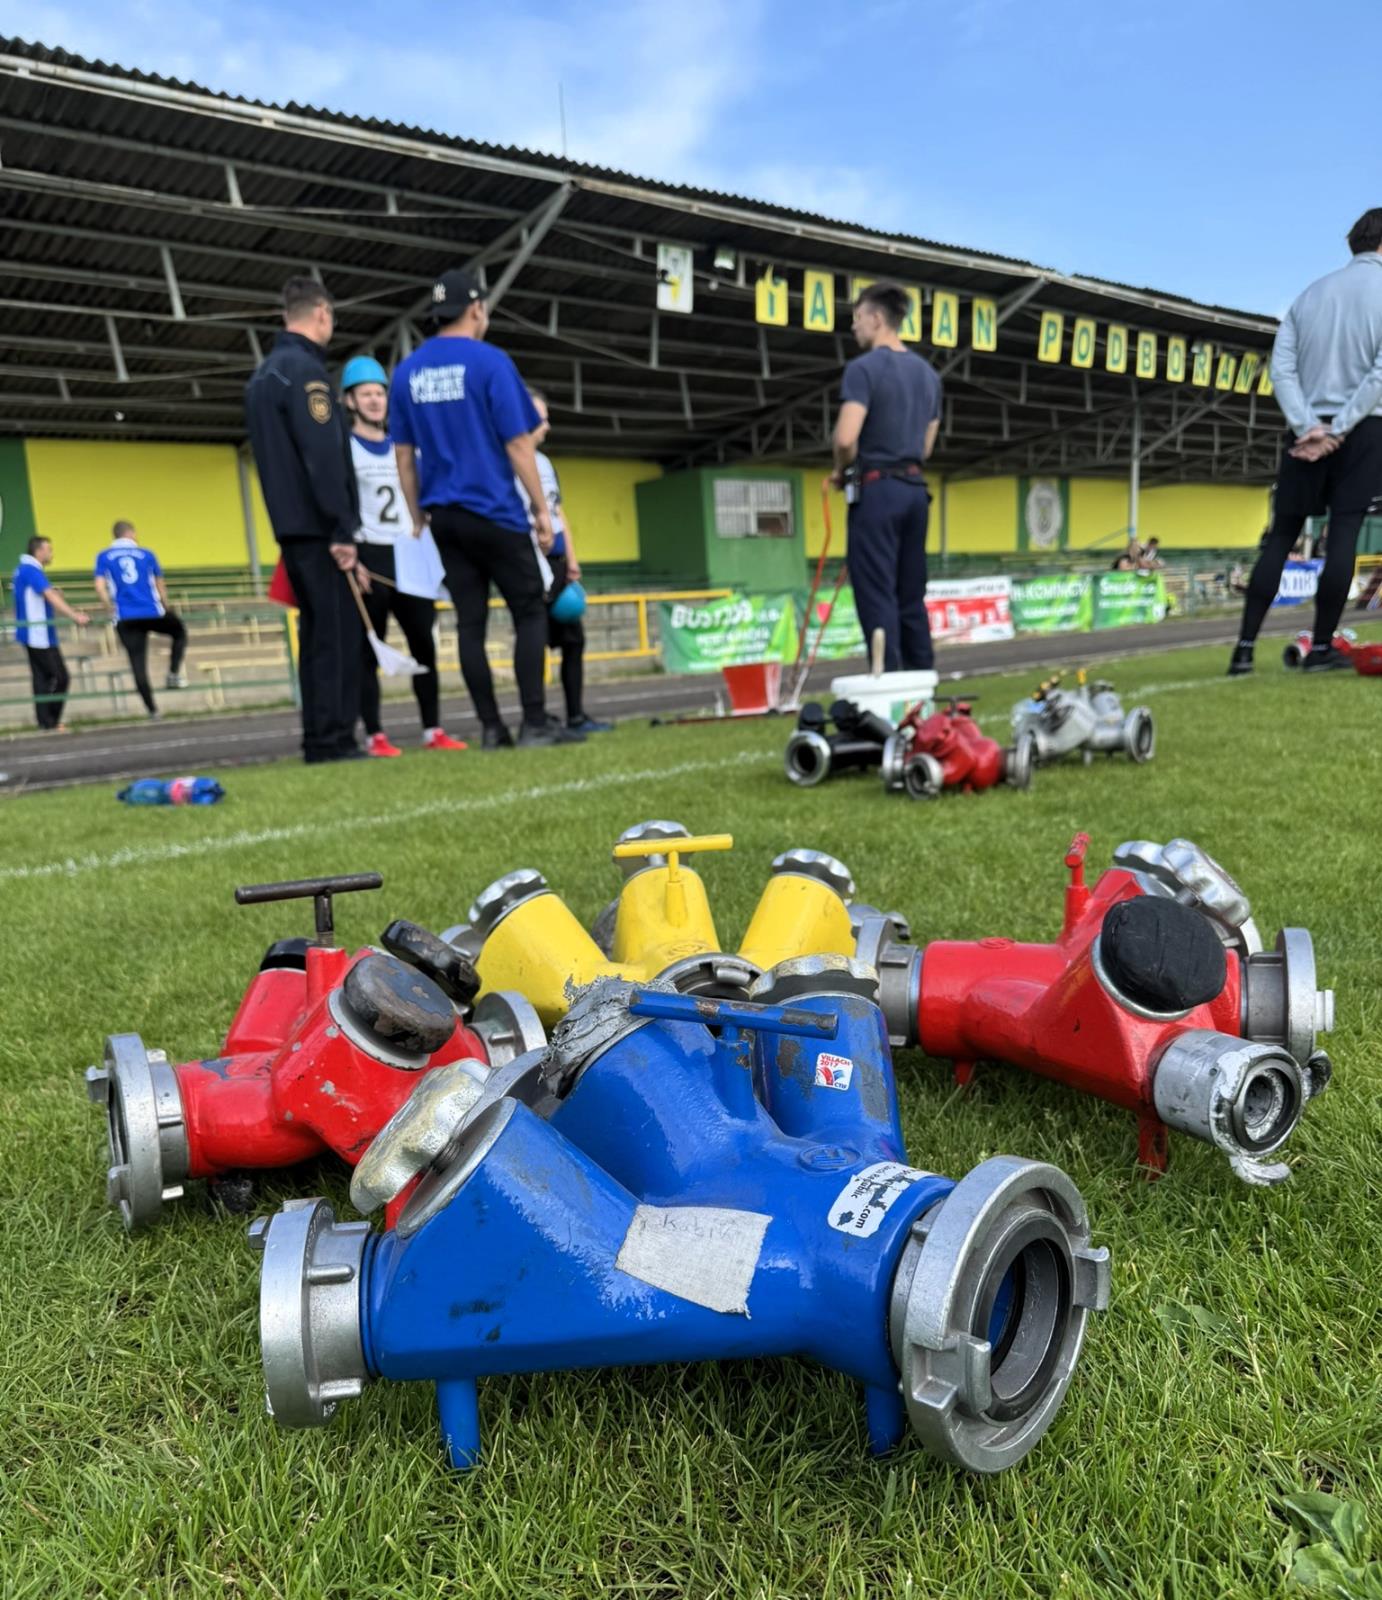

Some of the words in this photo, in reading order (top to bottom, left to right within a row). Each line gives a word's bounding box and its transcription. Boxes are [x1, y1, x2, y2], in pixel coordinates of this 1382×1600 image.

[1043, 319, 1272, 391] PODBORAN
[376, 485, 400, 524] 2
[118, 556, 139, 584] 3
[820, 1054, 851, 1067] VILLACH
[820, 1060, 839, 1068] 2017
